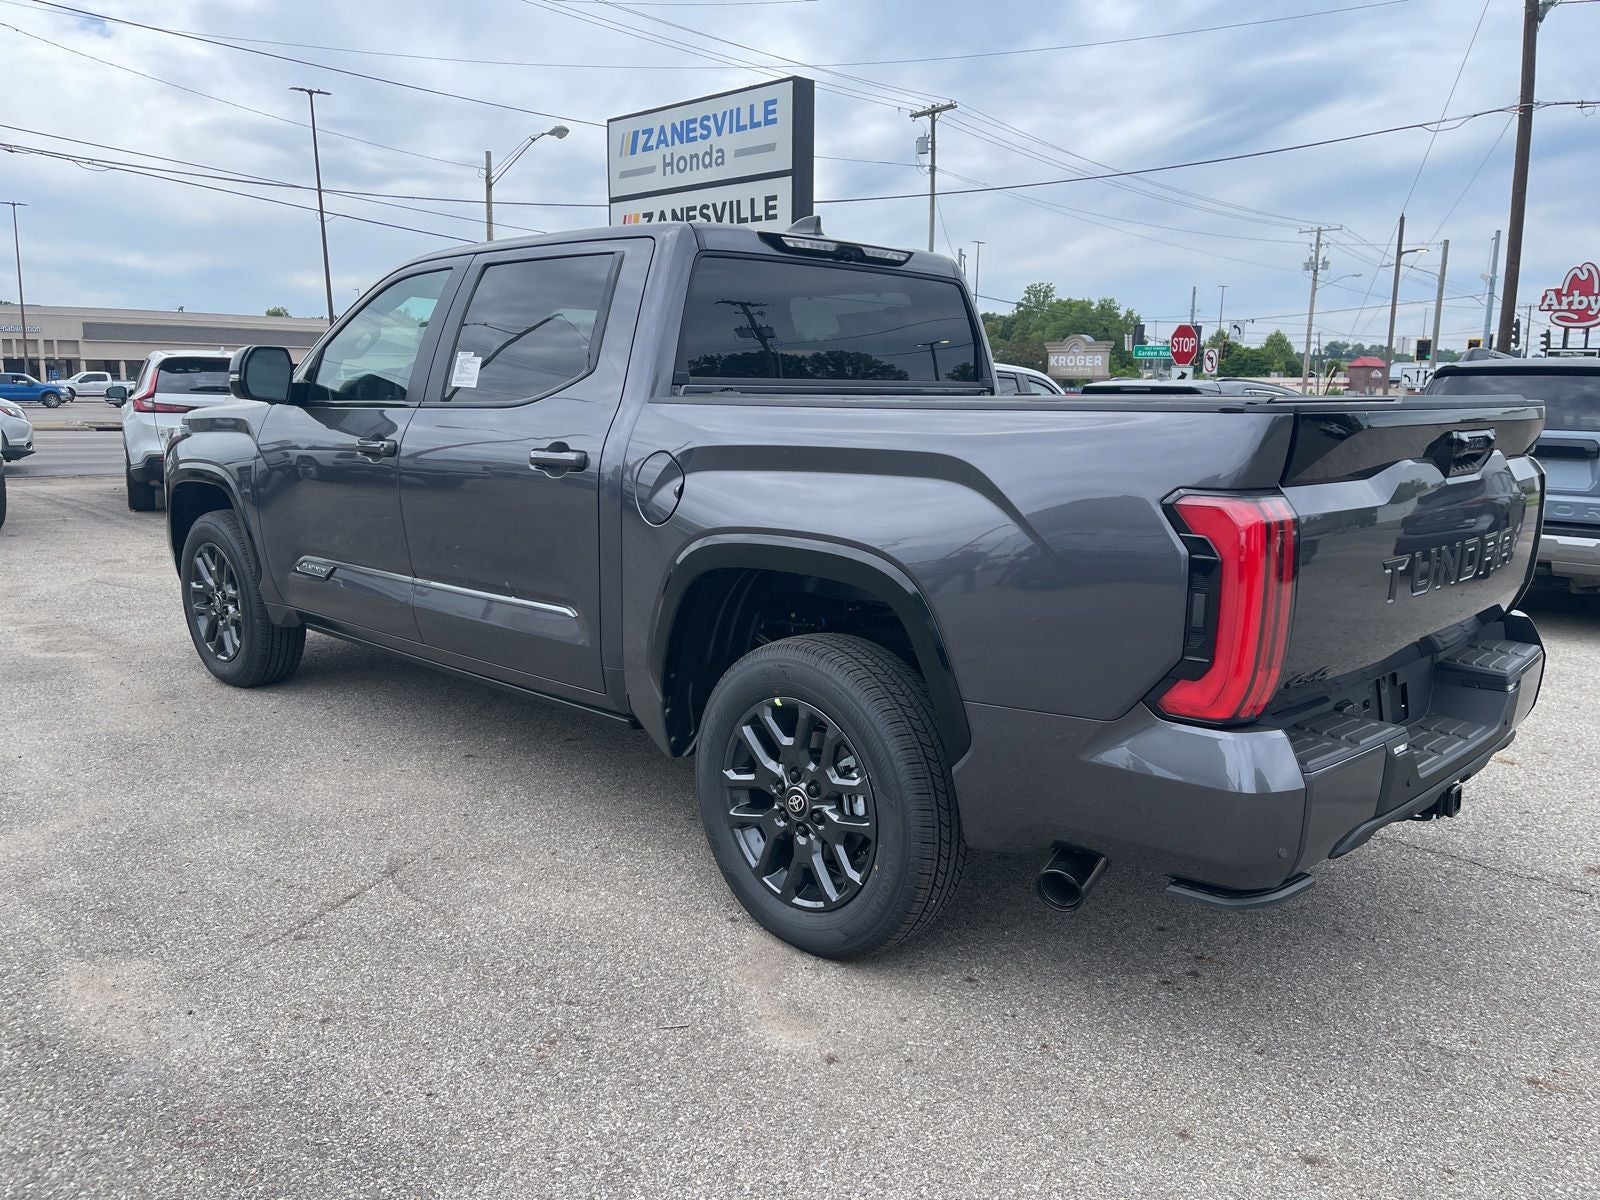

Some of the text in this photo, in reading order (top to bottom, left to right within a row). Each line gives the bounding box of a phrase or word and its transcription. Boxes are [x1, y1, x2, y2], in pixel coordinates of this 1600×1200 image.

[641, 98, 778, 153] ZANESVILLE
[662, 144, 726, 177] Honda
[1050, 355, 1102, 367] KROGER
[1172, 337, 1196, 353] STOP
[1382, 525, 1516, 604] TUNDRA
